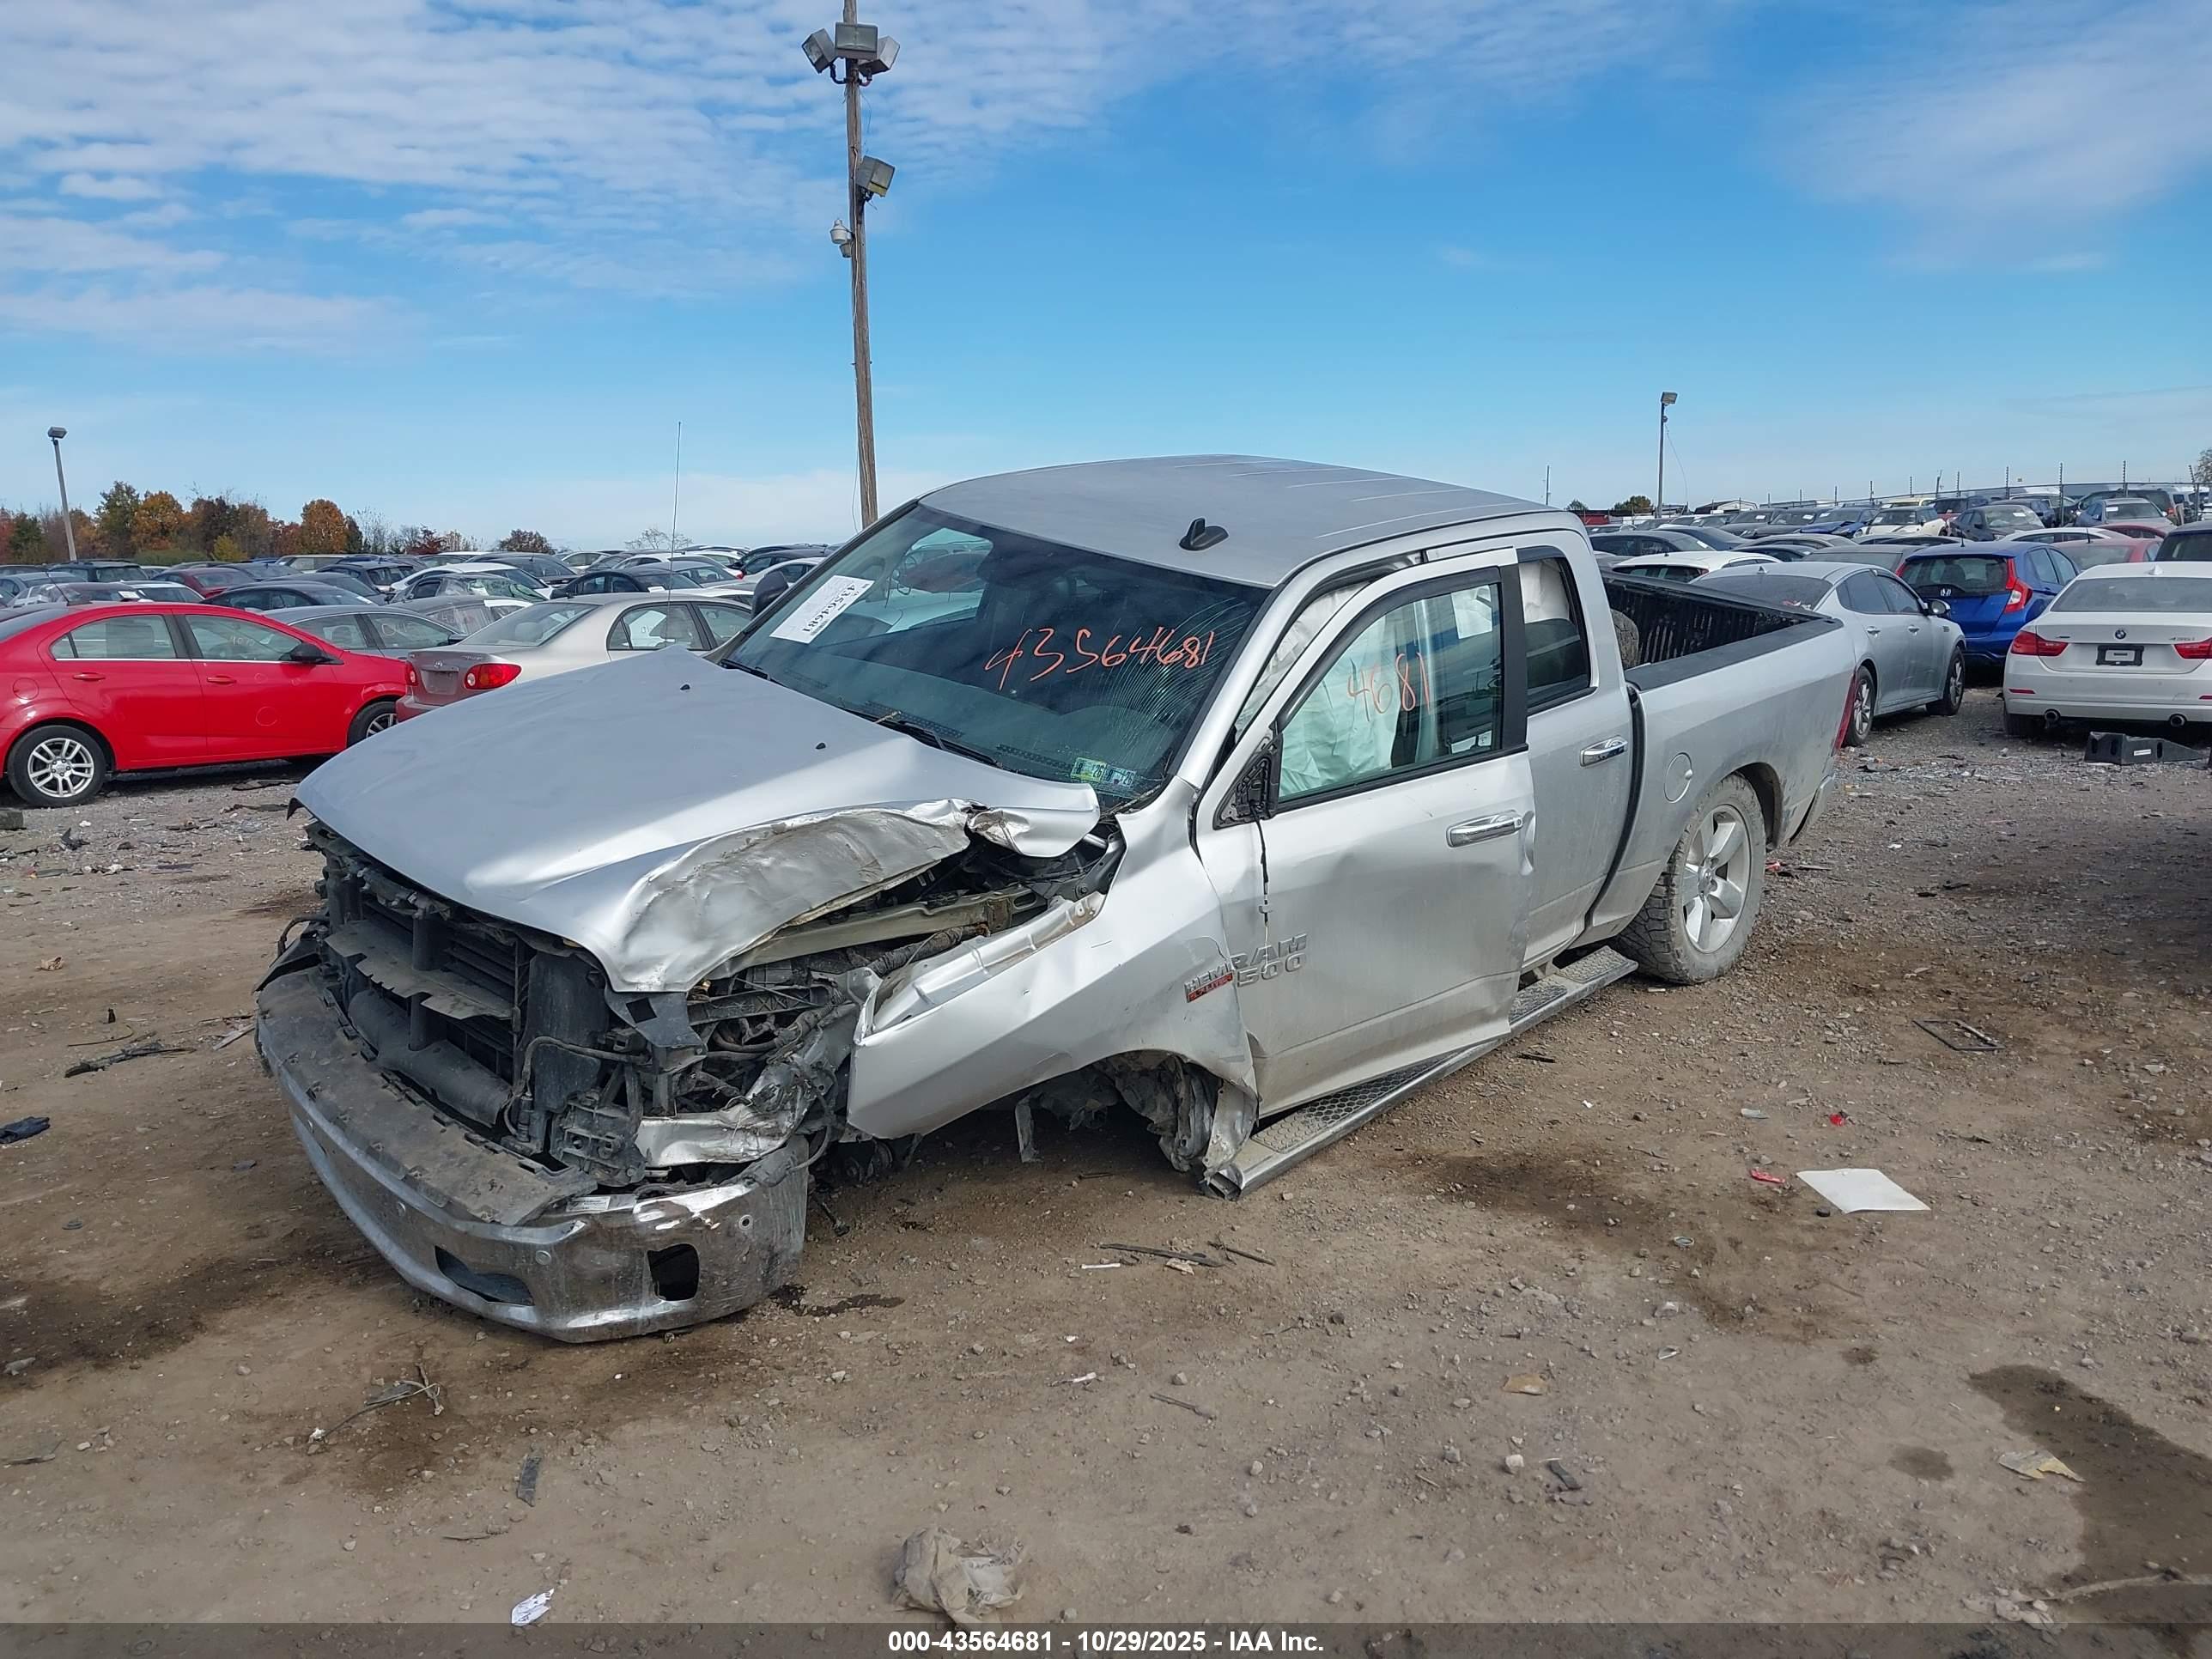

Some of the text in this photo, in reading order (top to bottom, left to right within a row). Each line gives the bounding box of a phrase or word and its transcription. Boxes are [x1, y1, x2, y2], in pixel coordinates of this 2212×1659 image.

[803, 583, 857, 632] 43564681
[984, 626, 1214, 691] 43564681
[1346, 652, 1431, 722] 4681
[1230, 933, 1307, 969] RAM
